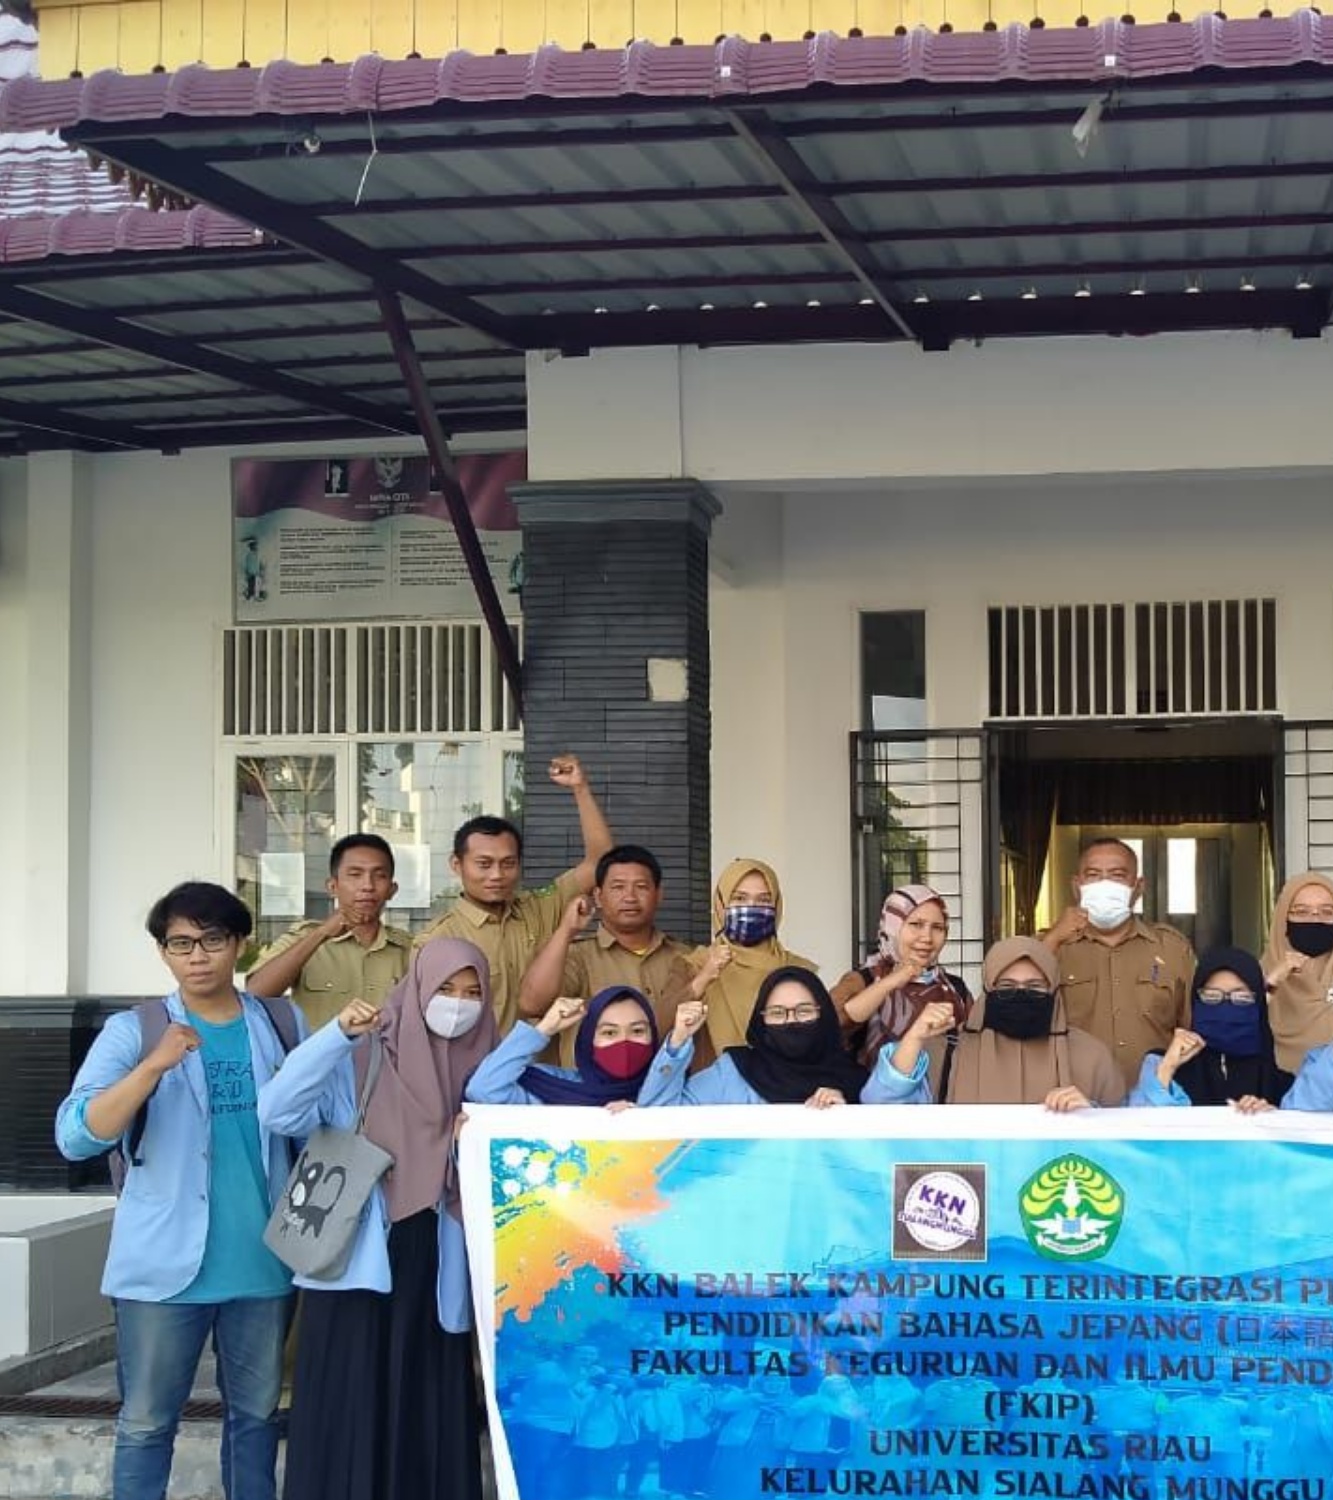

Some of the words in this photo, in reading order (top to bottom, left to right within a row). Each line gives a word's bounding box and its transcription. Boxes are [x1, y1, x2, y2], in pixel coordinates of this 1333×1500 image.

[920, 1185, 966, 1216] KKN
[607, 1271, 679, 1299] KKN
[694, 1271, 815, 1299] BALEK
[827, 1272, 1005, 1300] KAMPUNG
[1023, 1273, 1283, 1304] TERINTEGRASI
[662, 1310, 884, 1338] PENDIDIKAN
[898, 1311, 1045, 1340] BAHASA
[1058, 1313, 1203, 1341] JEPANG
[630, 1348, 810, 1377] FAKULTAS
[1033, 1351, 1108, 1380] DAN
[1124, 1351, 1217, 1382] ILMU
[983, 1390, 1096, 1426] (FKIP)
[869, 1429, 1110, 1462] UNIVERSITAS
[1123, 1434, 1212, 1463] RIAU
[759, 1466, 979, 1497] KELURAHAN
[994, 1469, 1151, 1500] SIALANG
